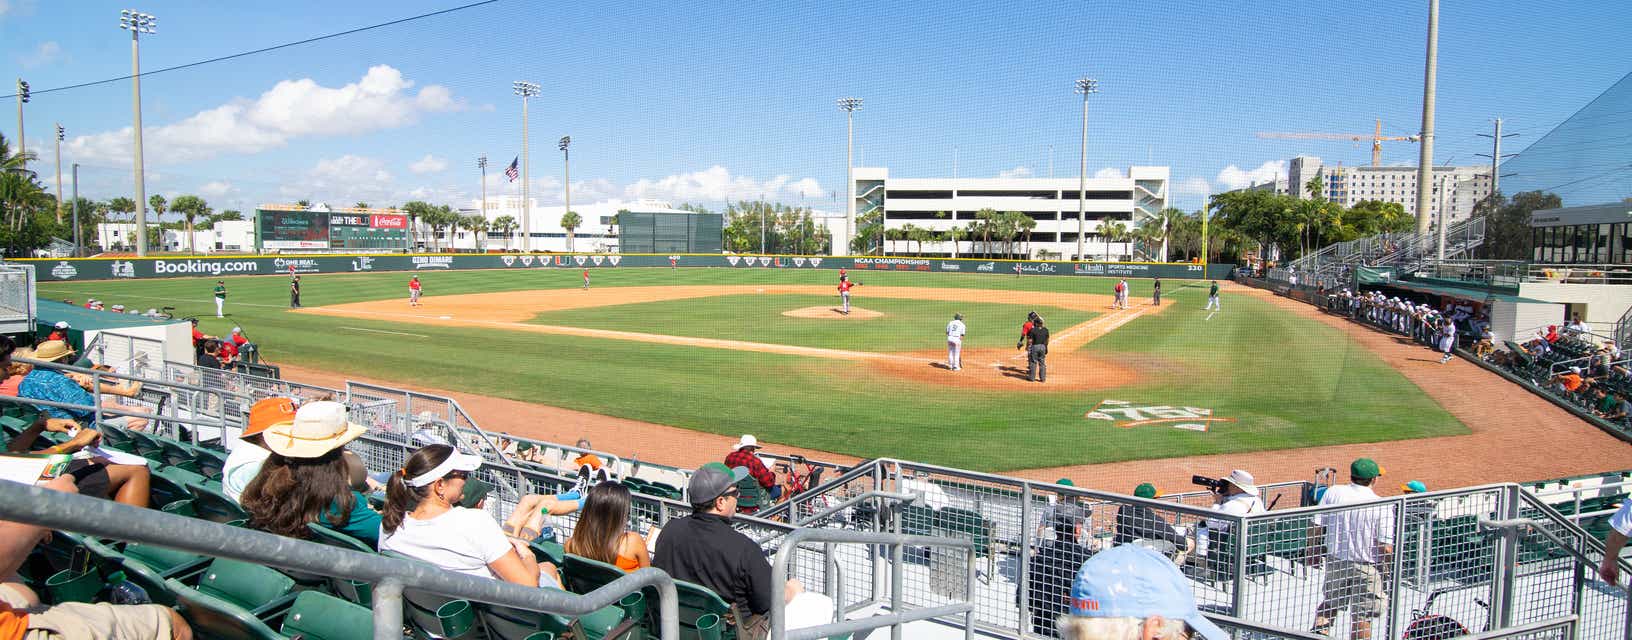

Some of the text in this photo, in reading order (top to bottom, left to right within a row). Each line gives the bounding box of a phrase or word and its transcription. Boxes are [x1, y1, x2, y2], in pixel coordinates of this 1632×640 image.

[379, 217, 402, 226] Coca-Cola
[874, 258, 930, 266] CHAMPIONSHIPS
[155, 259, 257, 275] Booking.com
